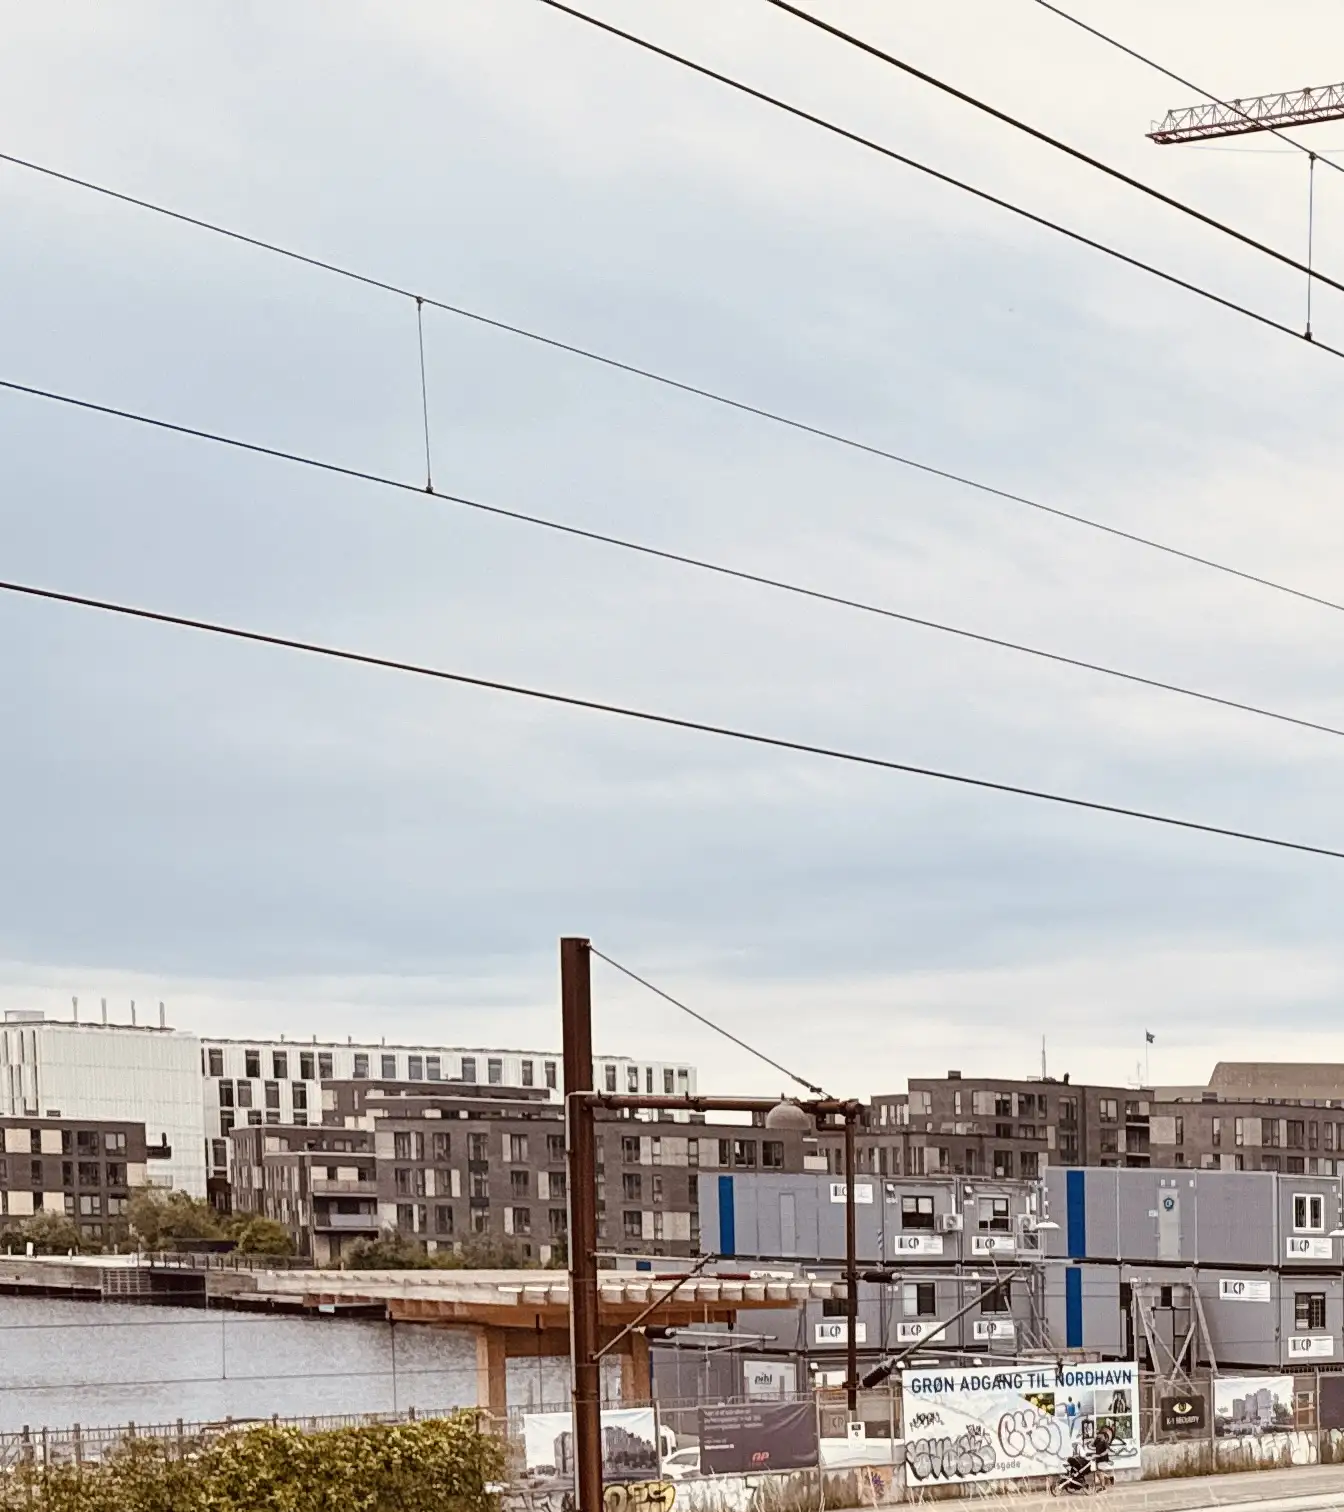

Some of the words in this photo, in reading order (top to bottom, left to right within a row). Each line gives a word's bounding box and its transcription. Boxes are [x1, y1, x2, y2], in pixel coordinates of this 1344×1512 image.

[911, 1377, 955, 1394] GRØN
[960, 1374, 1023, 1392] ADGANG
[1027, 1373, 1049, 1389] TIL
[1056, 1369, 1132, 1387] NORDHAVN
